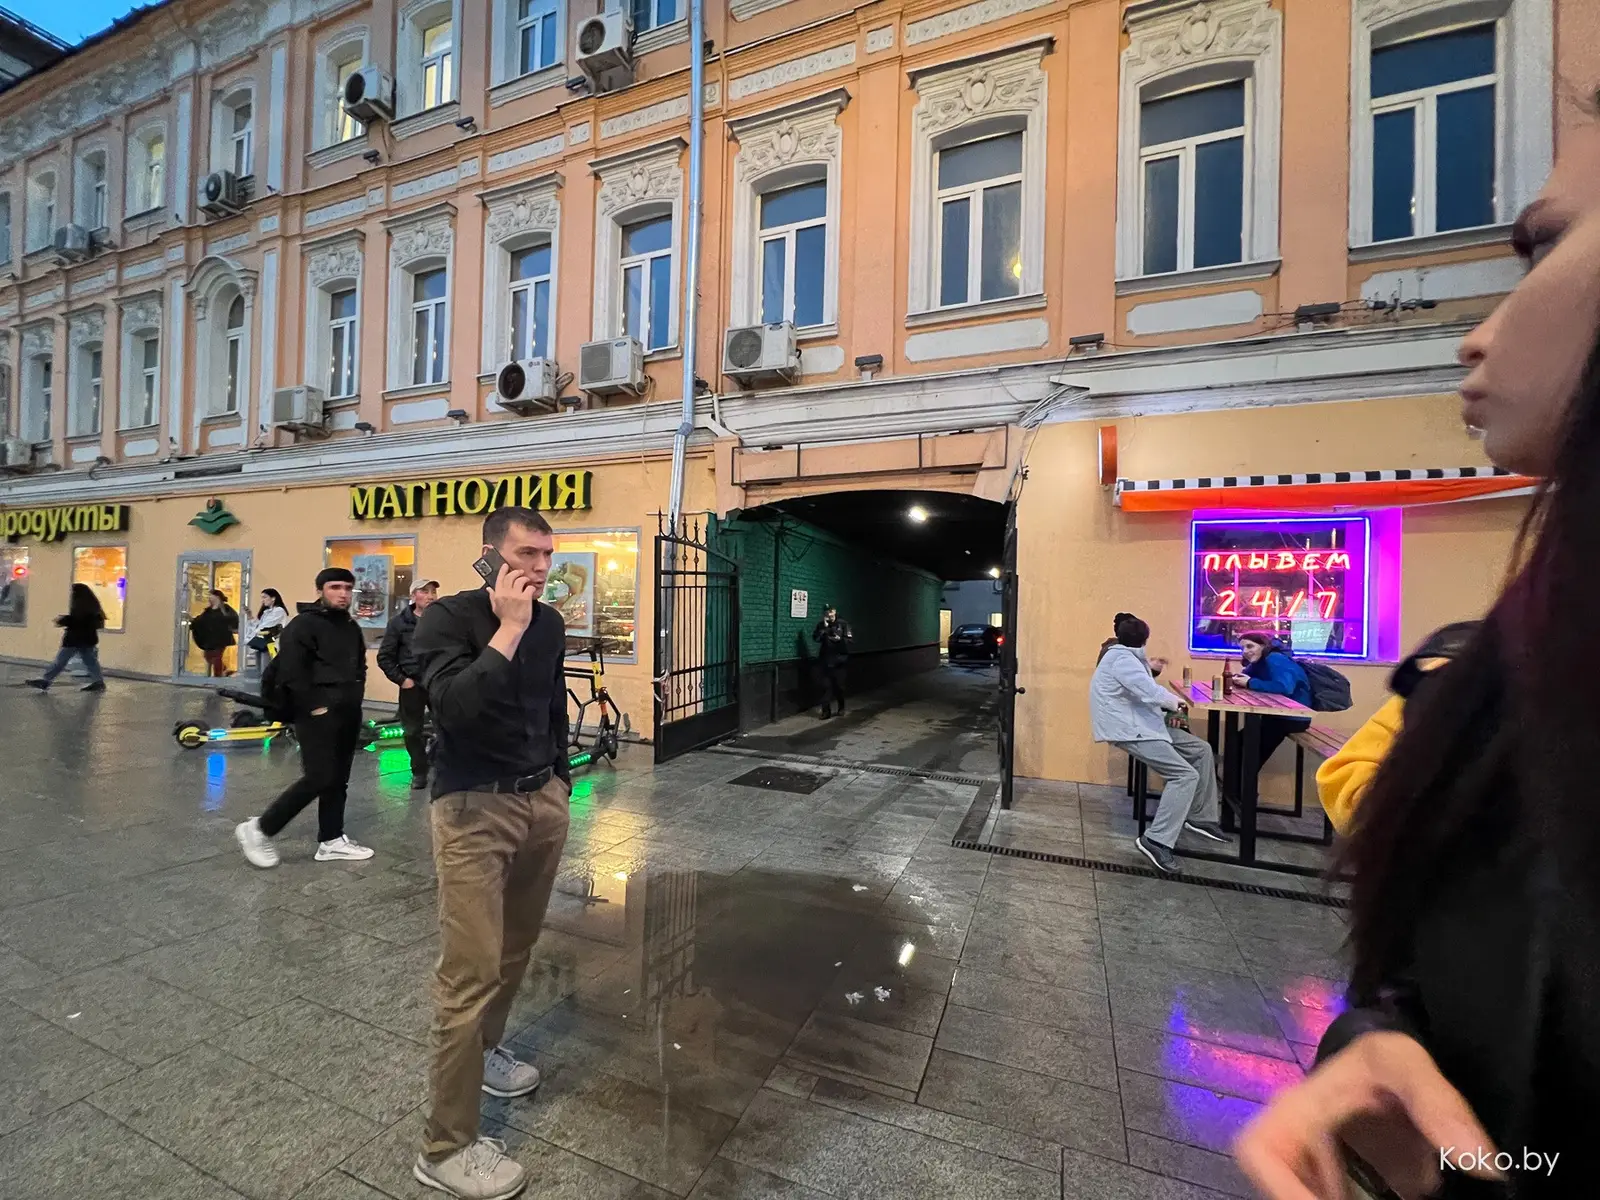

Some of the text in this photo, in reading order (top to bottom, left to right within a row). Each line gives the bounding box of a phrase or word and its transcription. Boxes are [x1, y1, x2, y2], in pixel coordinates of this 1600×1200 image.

[350, 470, 587, 520] МАГНОЛИЯ
[1203, 551, 1351, 571] ПЛЫВЕМ
[1216, 589, 1337, 619] 24/7
